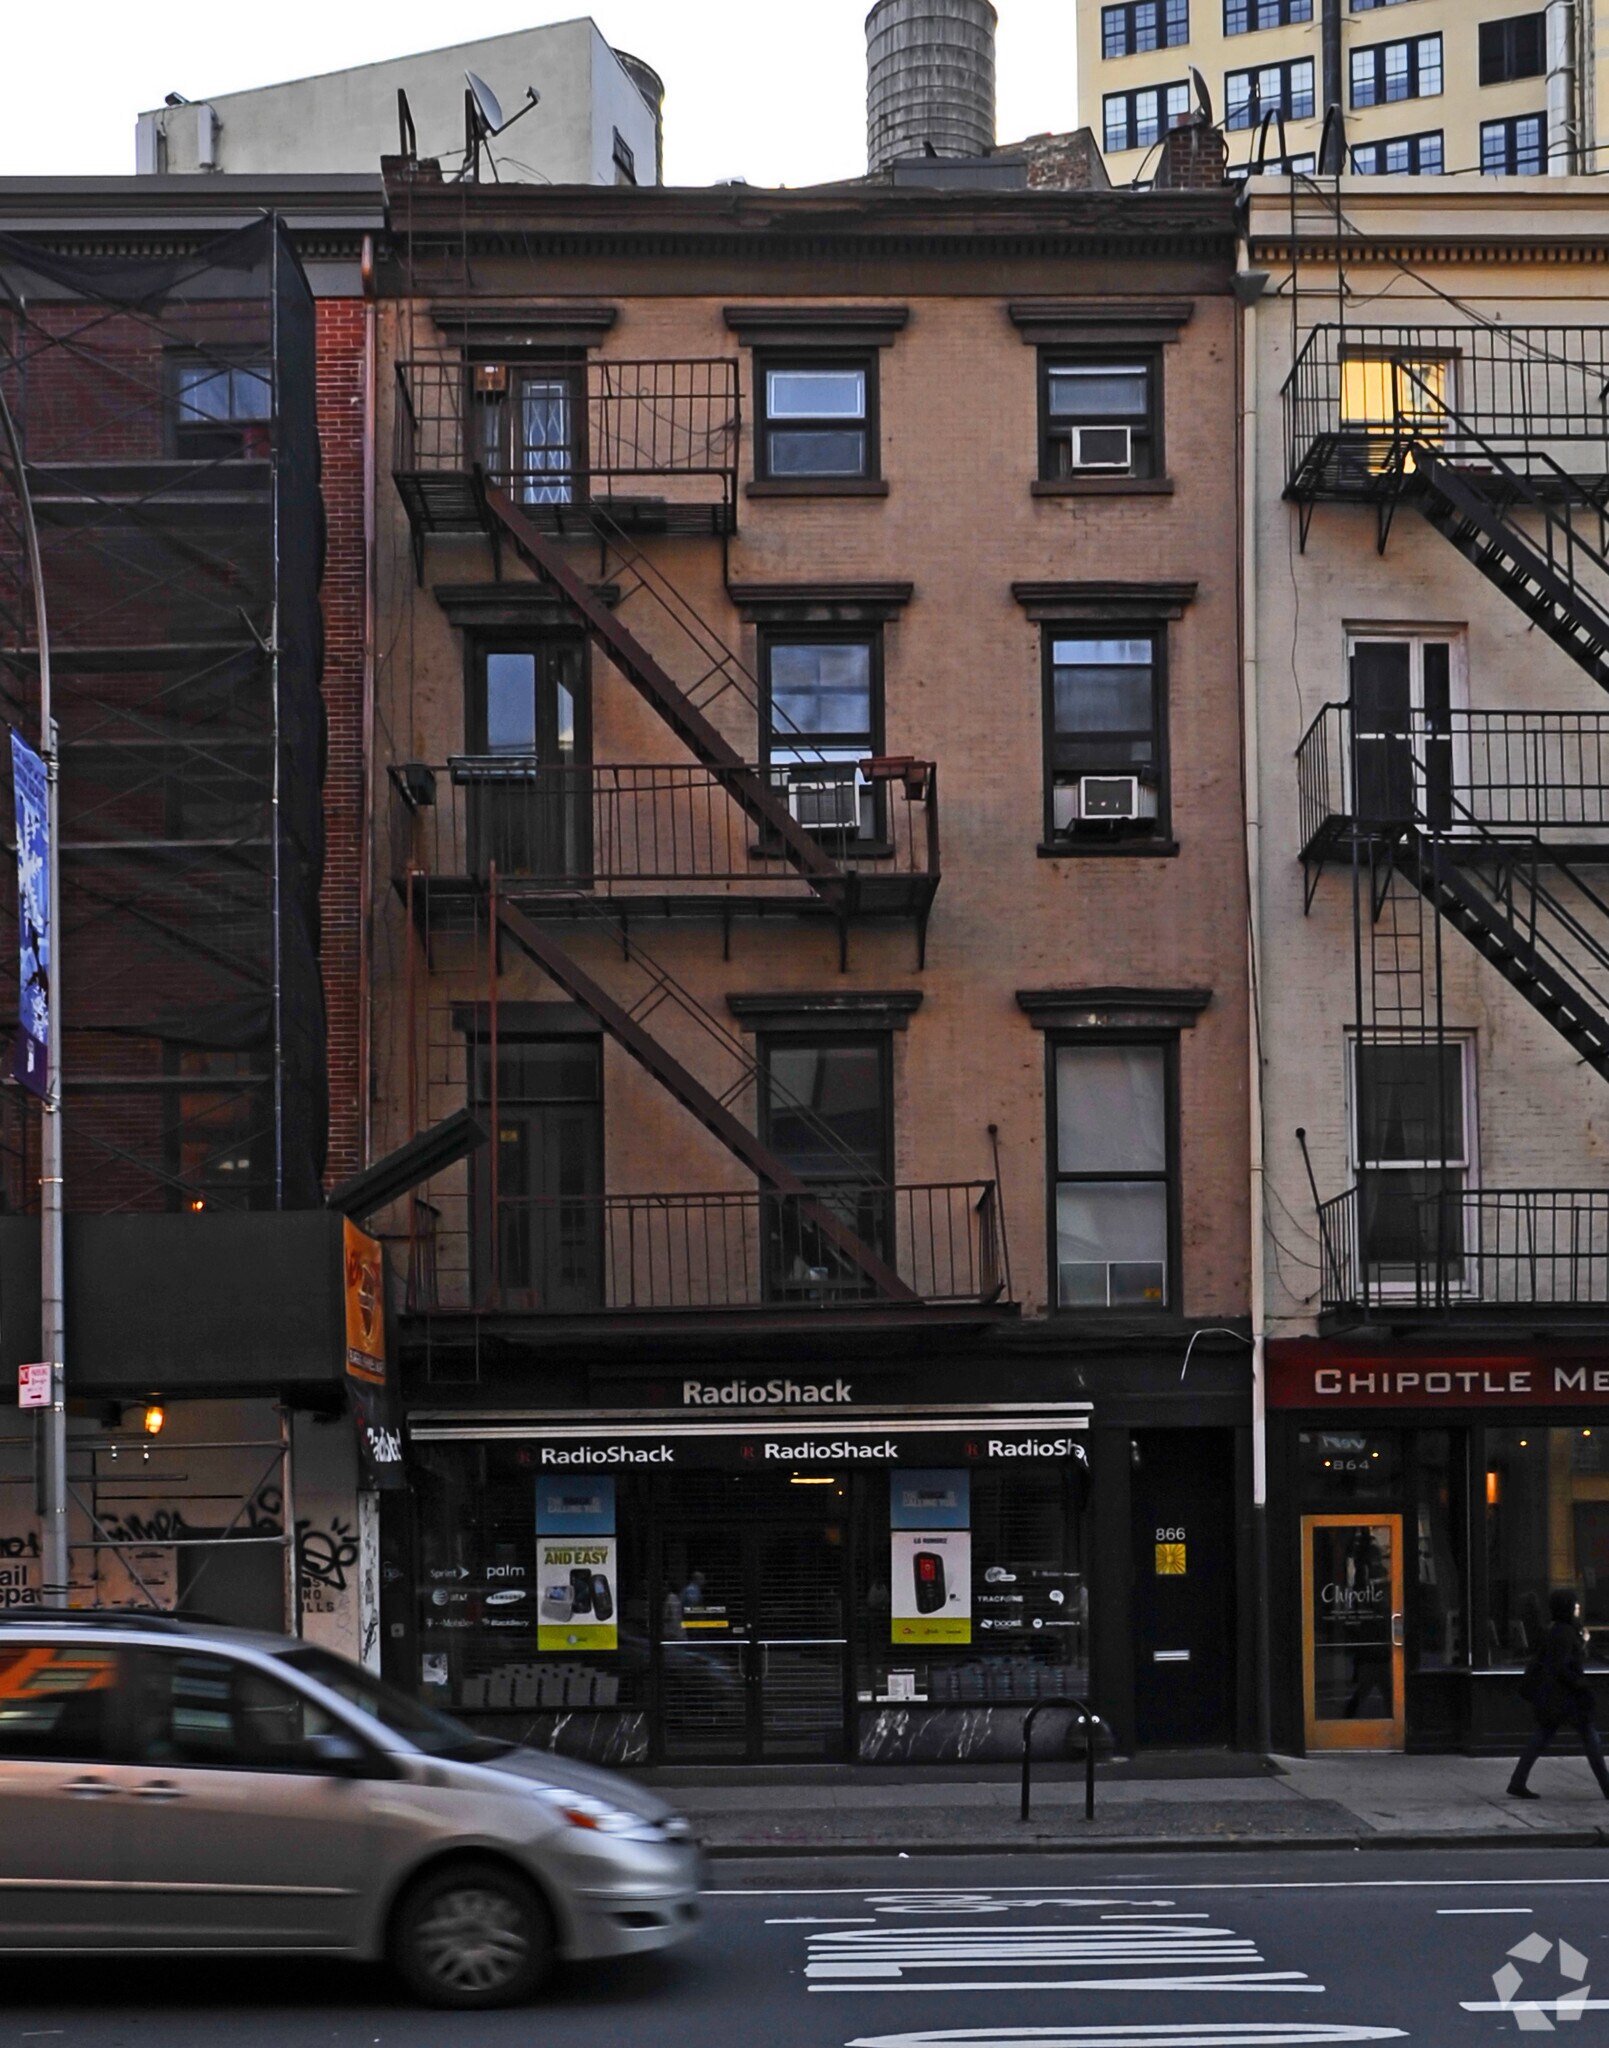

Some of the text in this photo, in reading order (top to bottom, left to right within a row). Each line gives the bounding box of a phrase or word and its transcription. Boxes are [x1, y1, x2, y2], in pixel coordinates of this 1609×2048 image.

[1314, 1369, 1532, 1394] CHIPOTLE
[683, 1378, 852, 1404] RadioShack
[541, 1444, 675, 1464] RadioShack
[764, 1440, 898, 1459] RadioShack
[1333, 1459, 1370, 1470] 864
[1155, 1527, 1186, 1541] 866
[544, 1551, 609, 1565] AND EASY
[430, 1568, 457, 1579] Sprint
[486, 1564, 525, 1580] palm
[490, 1592, 523, 1601] SAMSUNG
[977, 1595, 1024, 1603] TRACFONE
[1321, 1581, 1384, 1609] Chipotle
